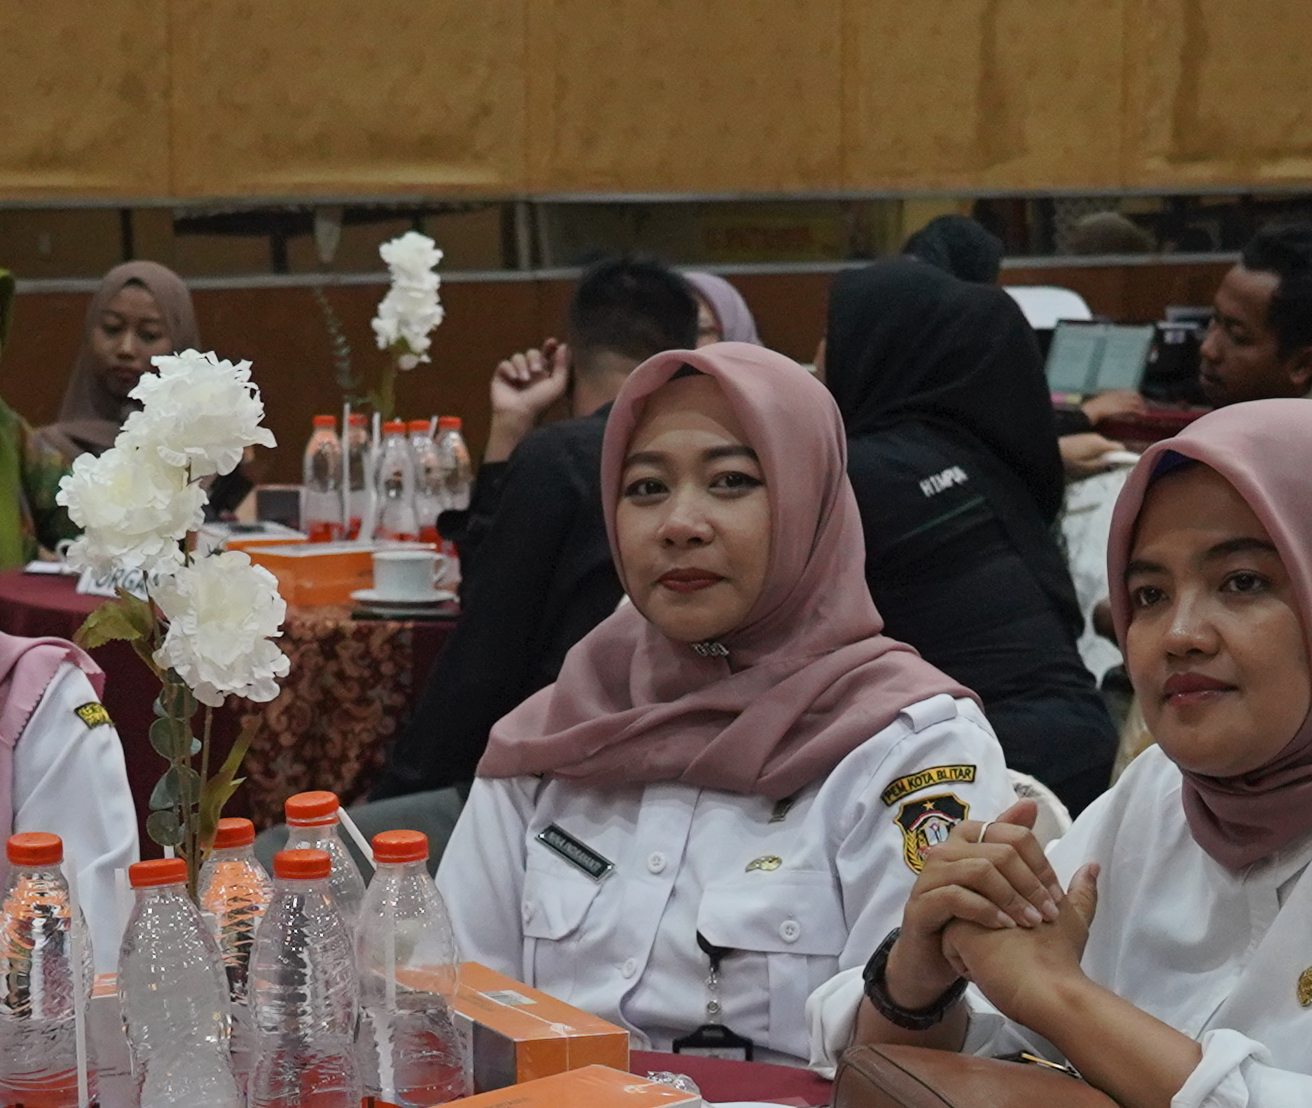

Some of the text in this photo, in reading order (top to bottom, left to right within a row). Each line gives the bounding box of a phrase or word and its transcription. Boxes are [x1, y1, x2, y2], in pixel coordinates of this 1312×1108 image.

[884, 768, 972, 801] PEM KOTA BLITAR
